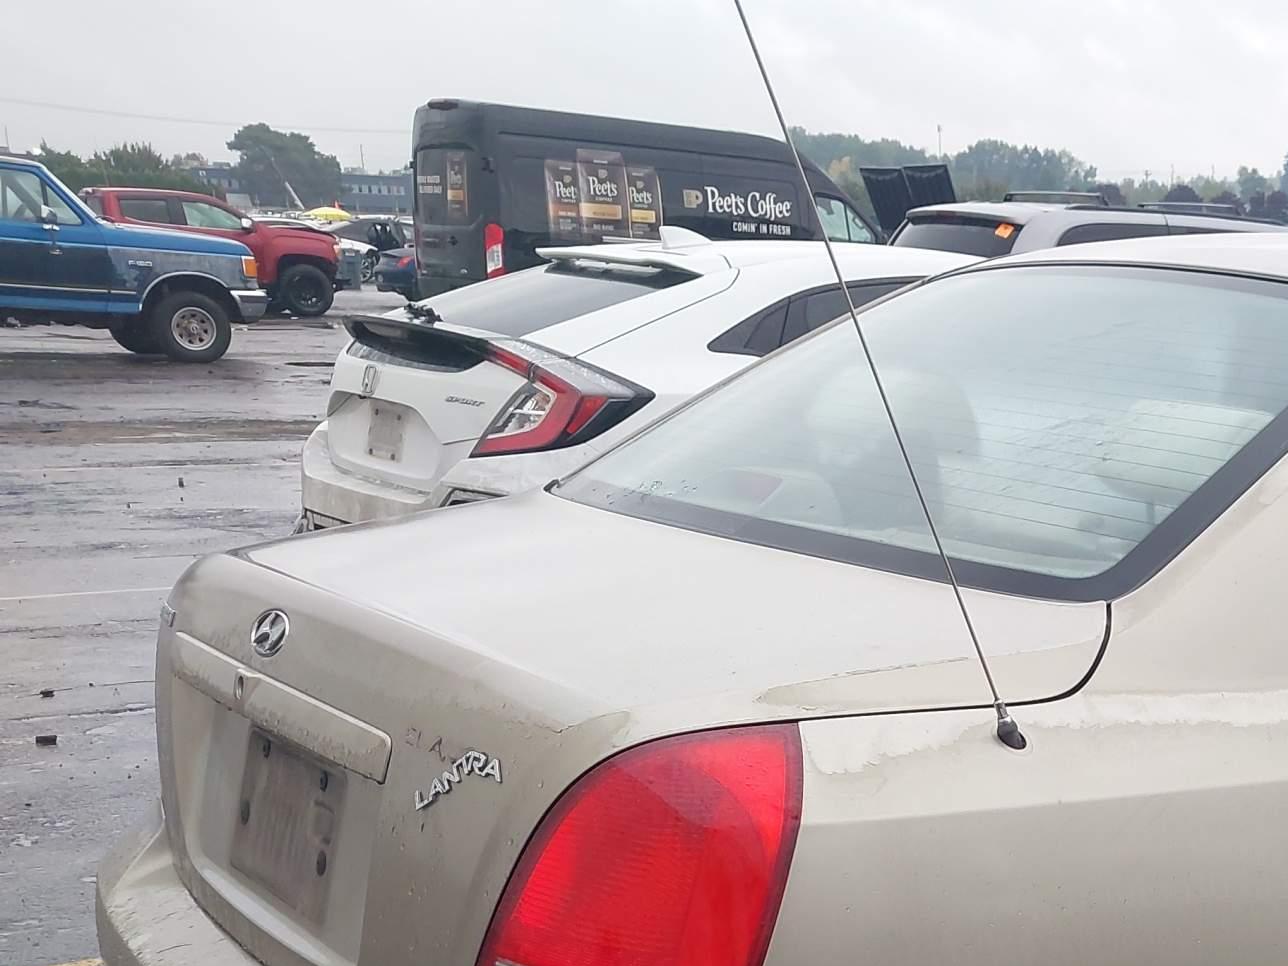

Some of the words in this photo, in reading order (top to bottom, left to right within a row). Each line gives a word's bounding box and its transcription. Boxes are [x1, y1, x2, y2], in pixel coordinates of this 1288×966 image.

[555, 181, 578, 199] Peet
[747, 191, 791, 221] Coffee
[759, 223, 768, 235] IN
[769, 224, 791, 236] FRESH
[414, 750, 503, 811] LANTRA
